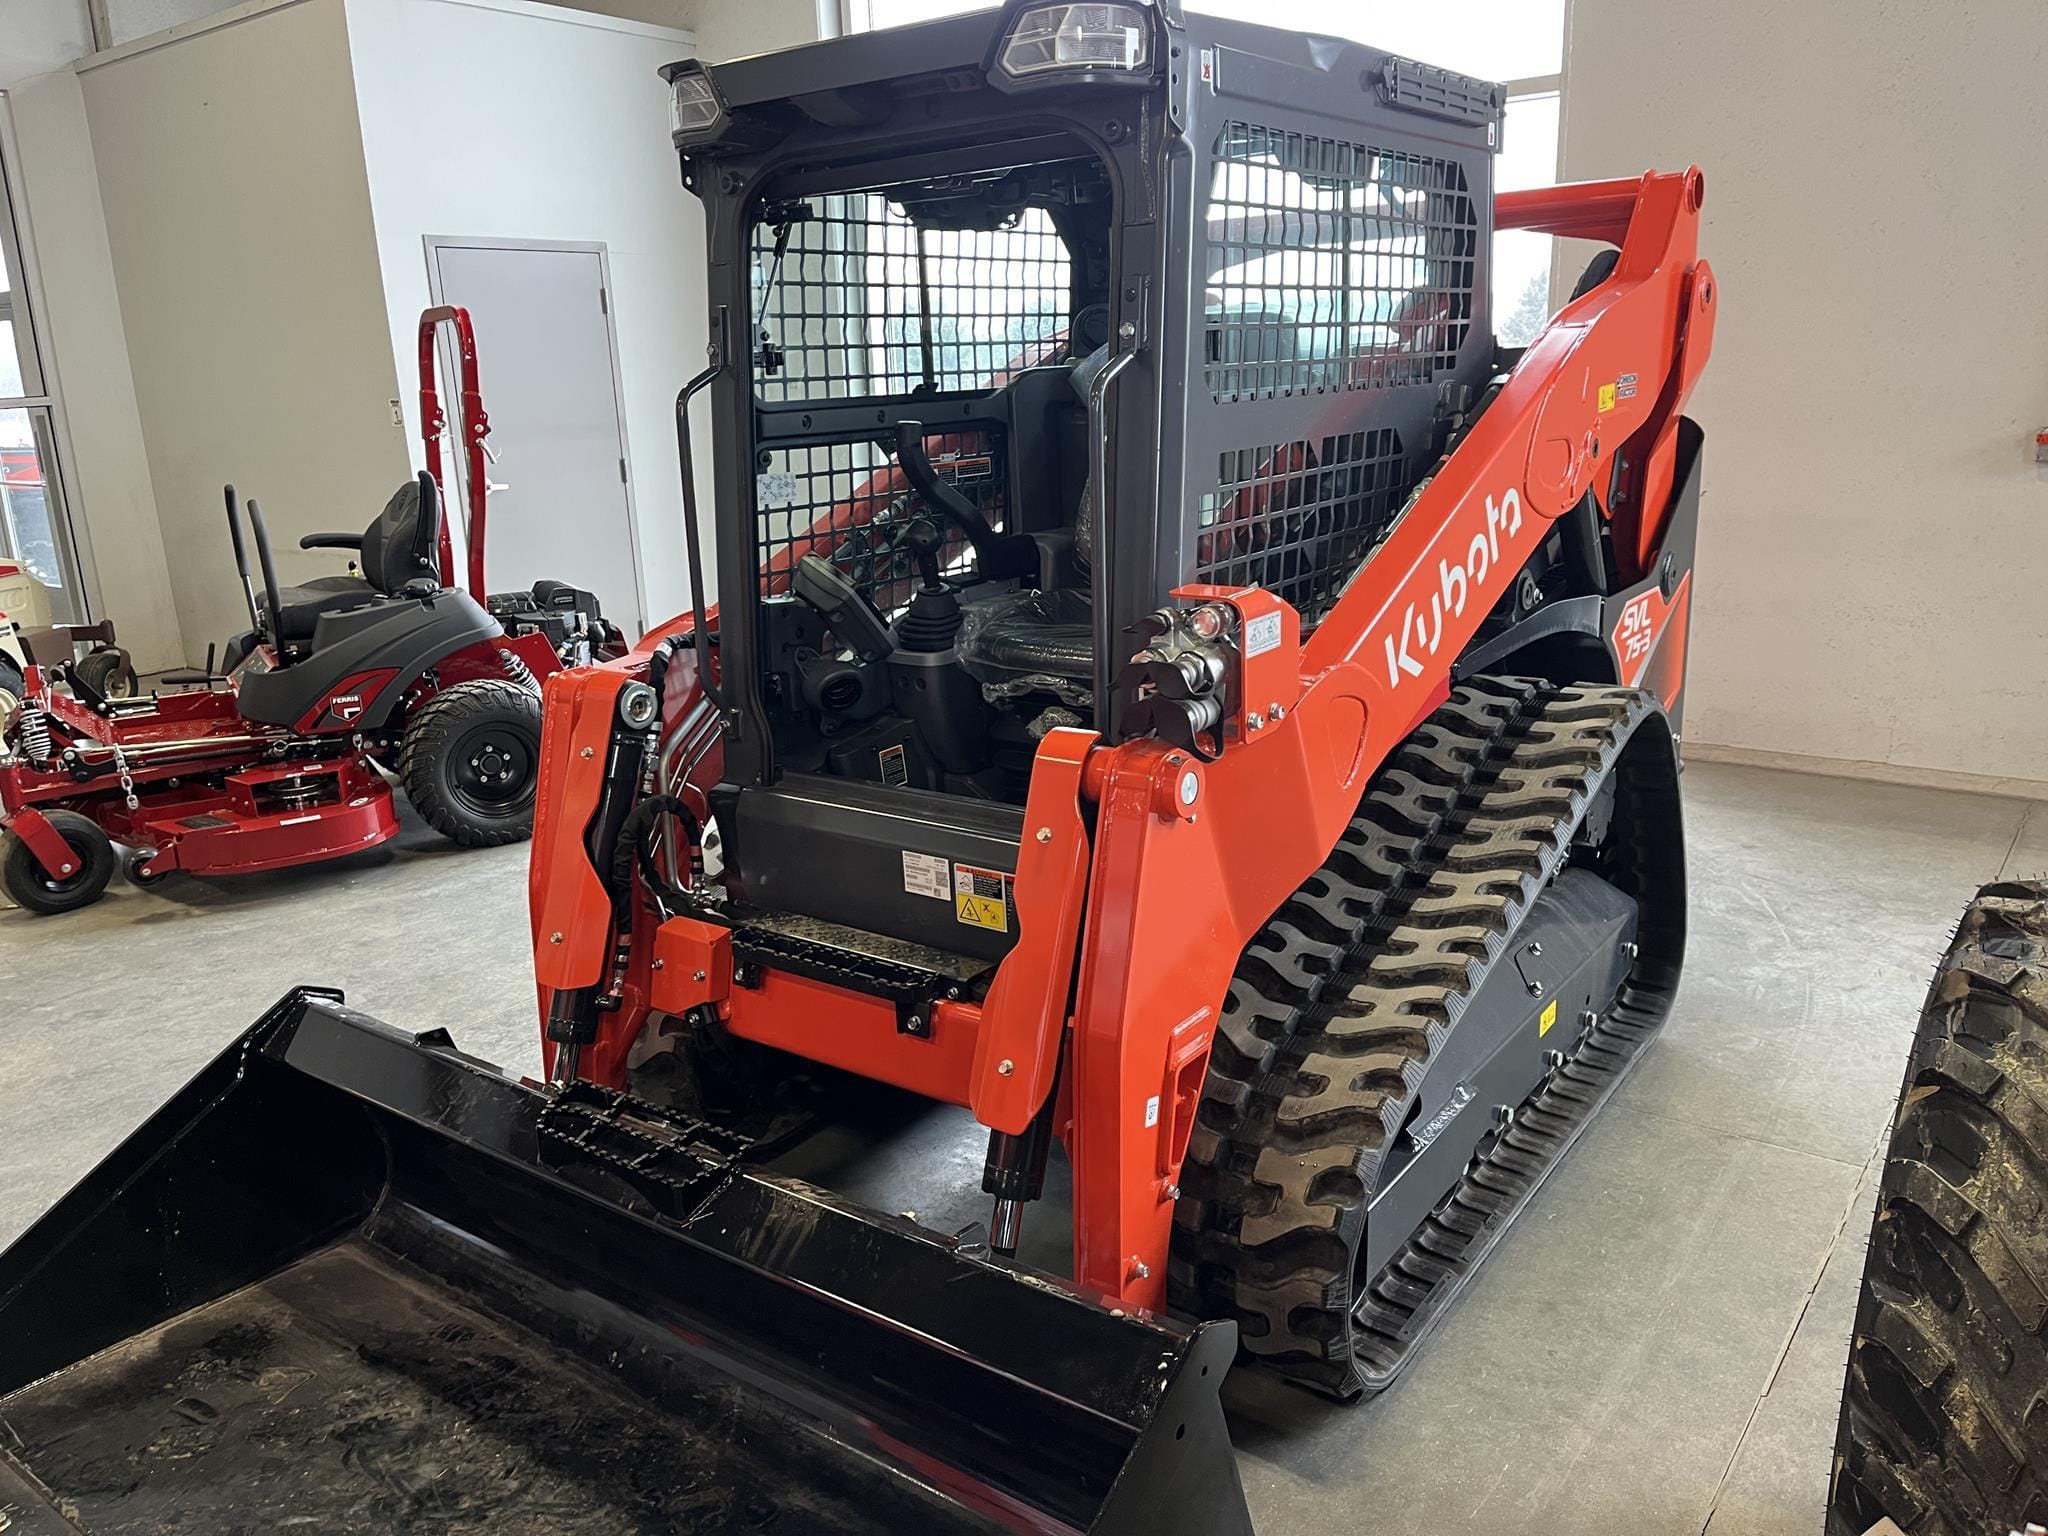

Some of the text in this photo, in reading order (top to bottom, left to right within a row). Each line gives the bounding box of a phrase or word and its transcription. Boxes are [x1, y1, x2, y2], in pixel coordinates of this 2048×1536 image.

[1384, 488, 1522, 689] Kubota
[1621, 599, 1652, 639] SVL
[1625, 628, 1651, 663] 75-3
[332, 695, 359, 704] FERRIS
